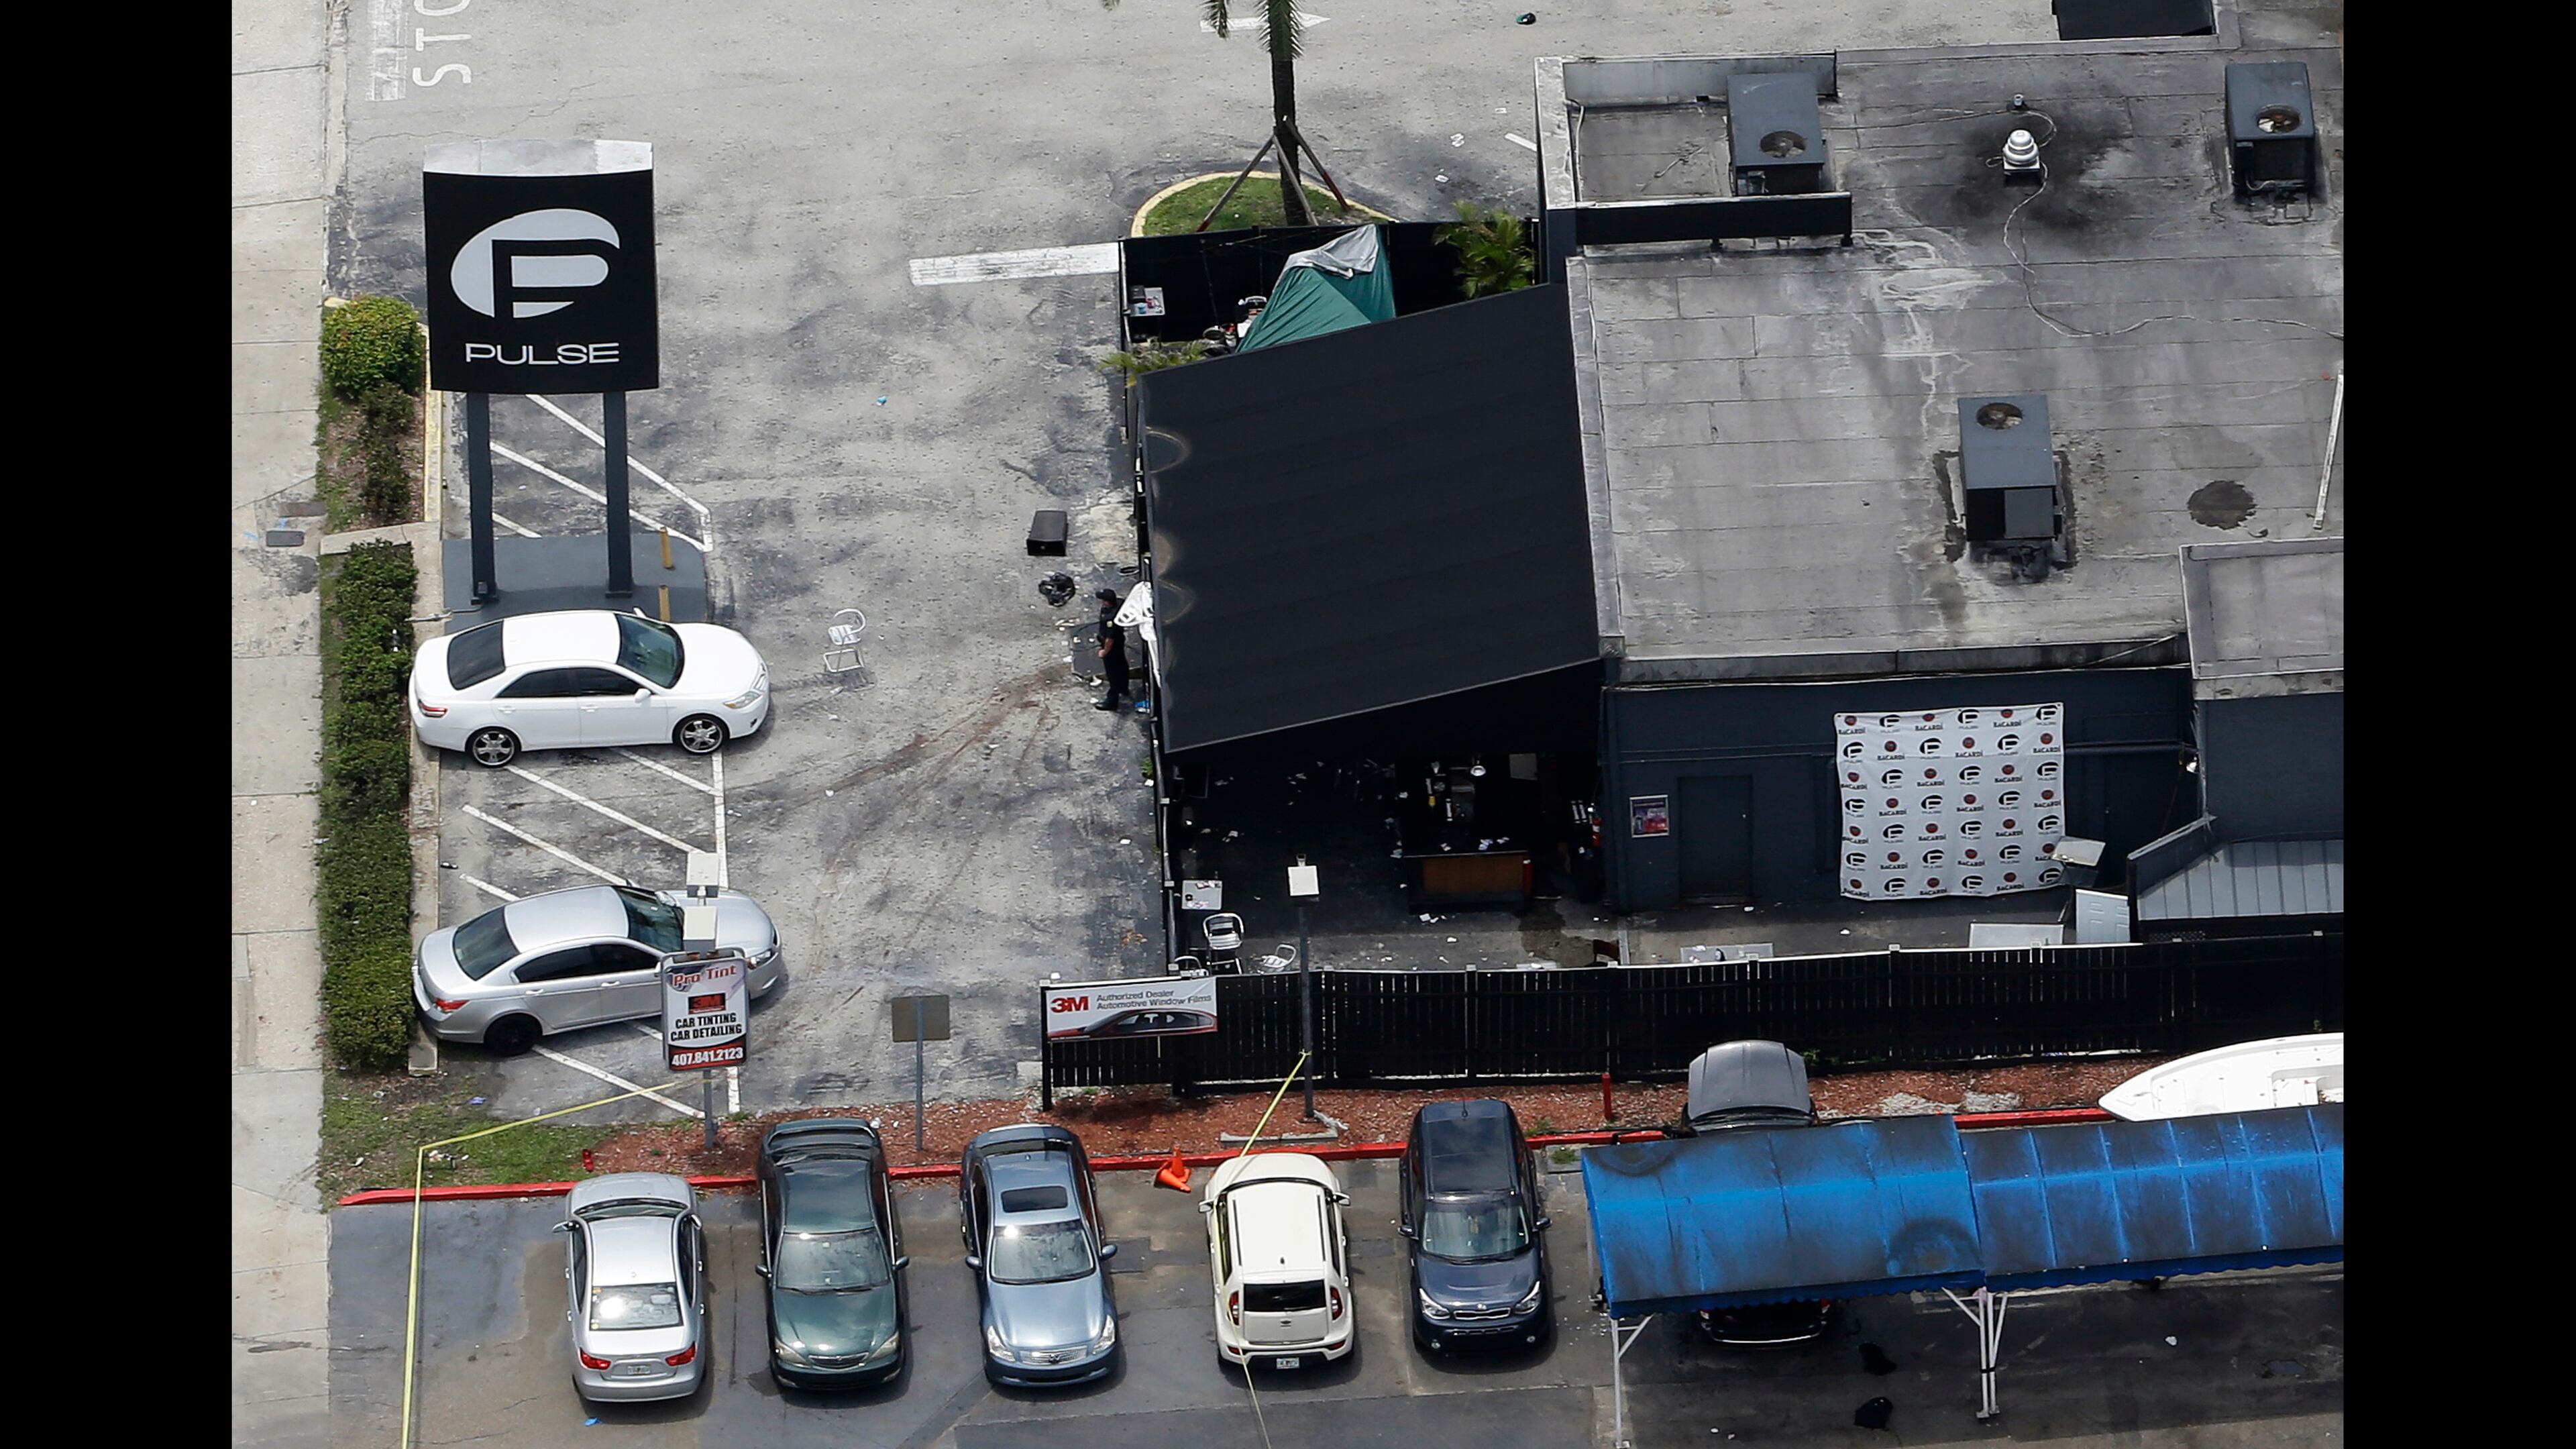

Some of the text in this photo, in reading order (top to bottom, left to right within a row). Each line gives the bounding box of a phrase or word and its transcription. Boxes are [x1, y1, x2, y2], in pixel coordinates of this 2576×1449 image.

[465, 343, 620, 365] PULSE
[673, 965, 737, 986] Pro Tint
[1097, 989, 1174, 1002] Authorized Dealer
[1097, 994, 1212, 1010] Automotive Window Films
[1051, 996, 1089, 1014] 3M
[676, 1013, 737, 1029] CAR TINTING
[671, 1024, 742, 1041] CAR DETAILING
[672, 1047, 744, 1066] 407.841.2123
